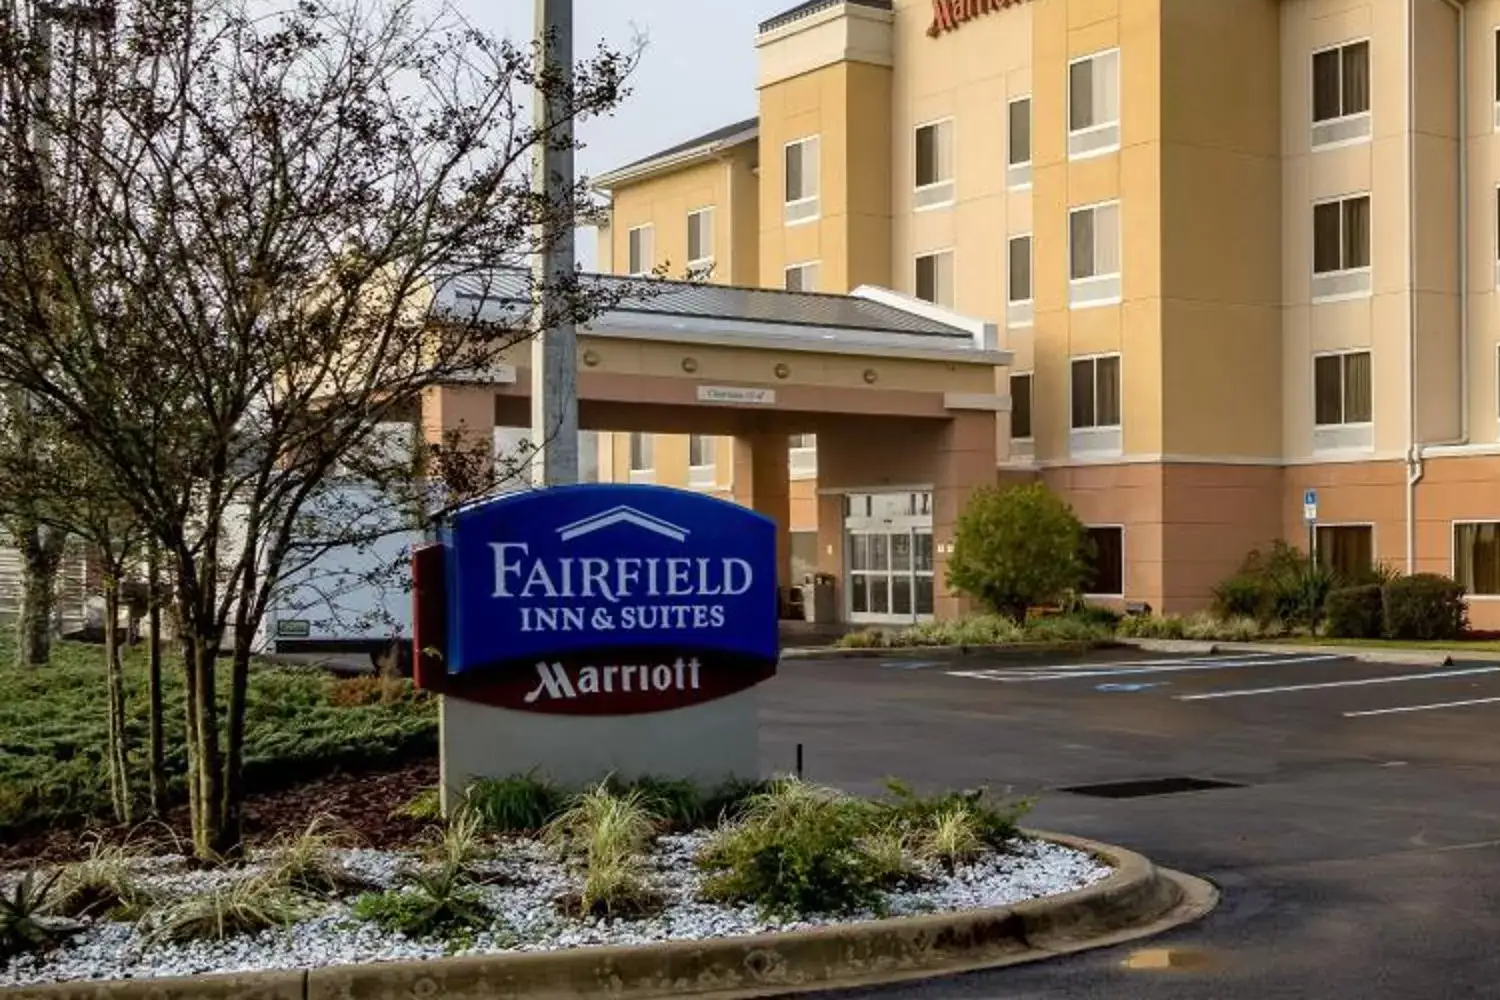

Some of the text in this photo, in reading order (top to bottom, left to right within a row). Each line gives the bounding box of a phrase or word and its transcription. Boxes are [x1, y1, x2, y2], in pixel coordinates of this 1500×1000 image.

[487, 541, 754, 603] FAIRFIELD
[519, 604, 725, 632] INN & SUITES
[523, 656, 703, 703] Marriott
